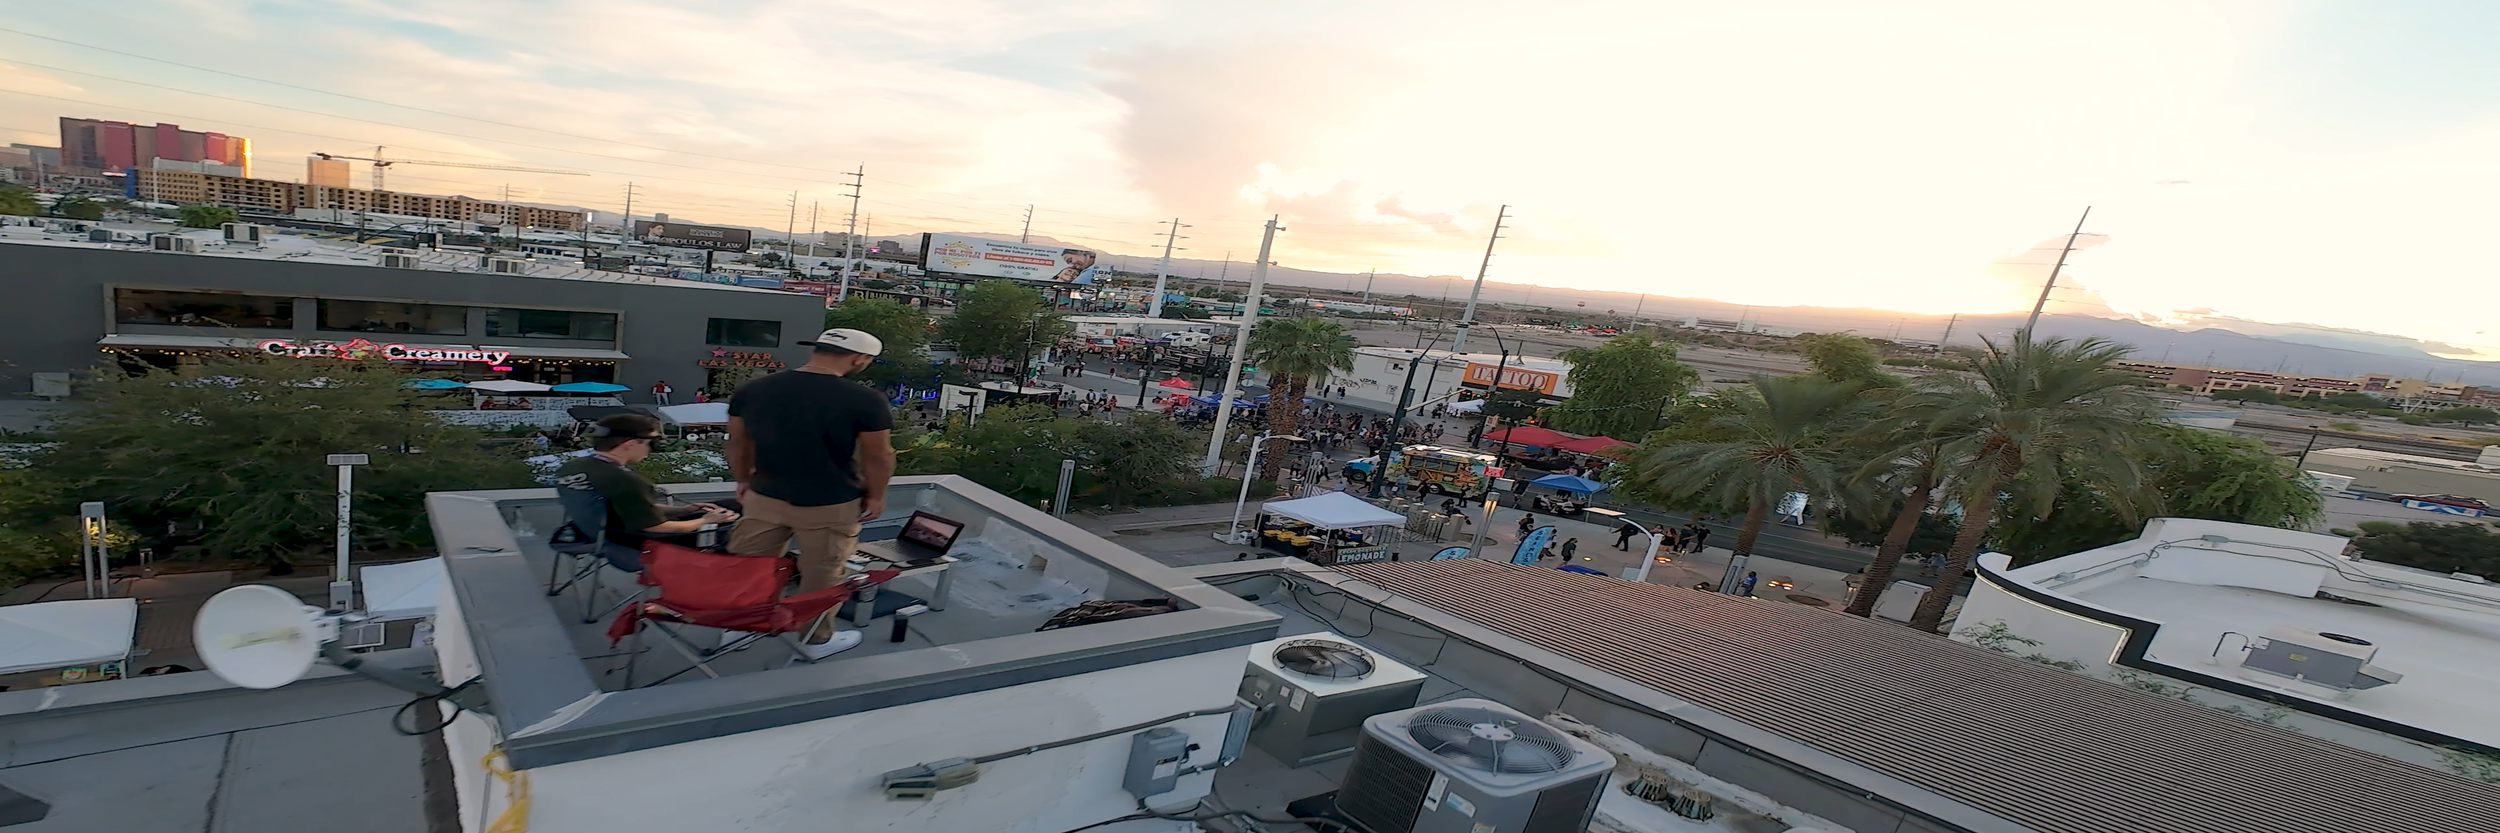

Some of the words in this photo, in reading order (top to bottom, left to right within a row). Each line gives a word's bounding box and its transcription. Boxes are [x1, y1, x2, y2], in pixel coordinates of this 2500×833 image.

[716, 241, 742, 249] LAW
[384, 343, 509, 364] Creamery
[731, 351, 772, 360] STAR
[697, 359, 727, 367] LAS
[734, 360, 786, 368] VEGAS
[1336, 550, 1386, 563] LEMONADE
